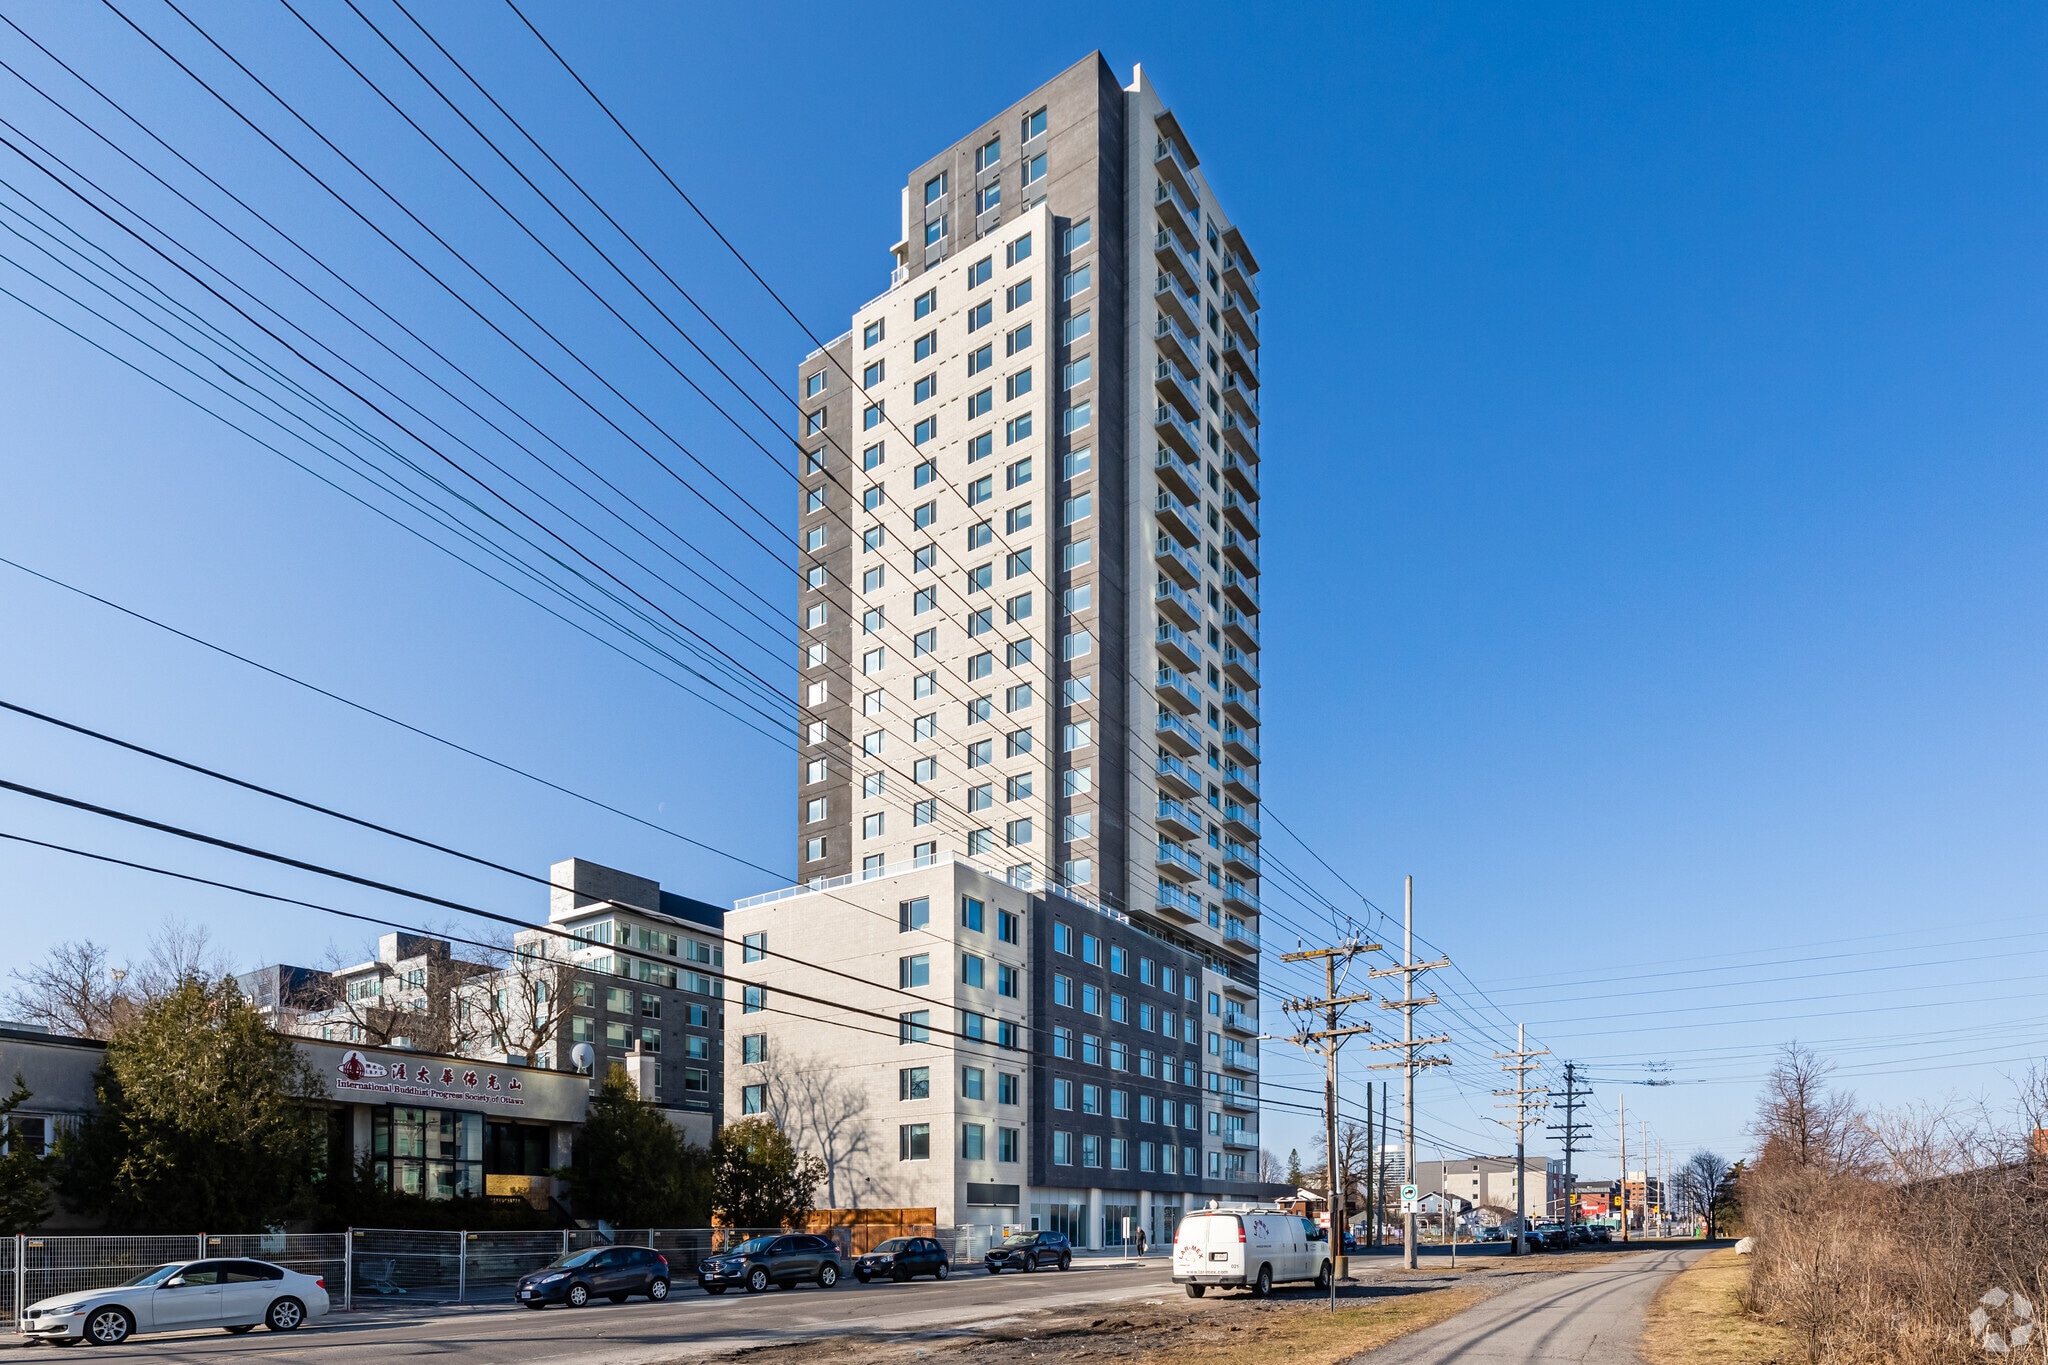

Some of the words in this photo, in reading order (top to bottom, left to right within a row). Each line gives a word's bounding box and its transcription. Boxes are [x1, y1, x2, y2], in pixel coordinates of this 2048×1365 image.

[337, 1080, 392, 1092] International
[394, 1086, 429, 1096] Buddhist
[431, 1090, 463, 1099] Progress
[465, 1093, 490, 1103] Society
[500, 1097, 524, 1105] Ottawa
